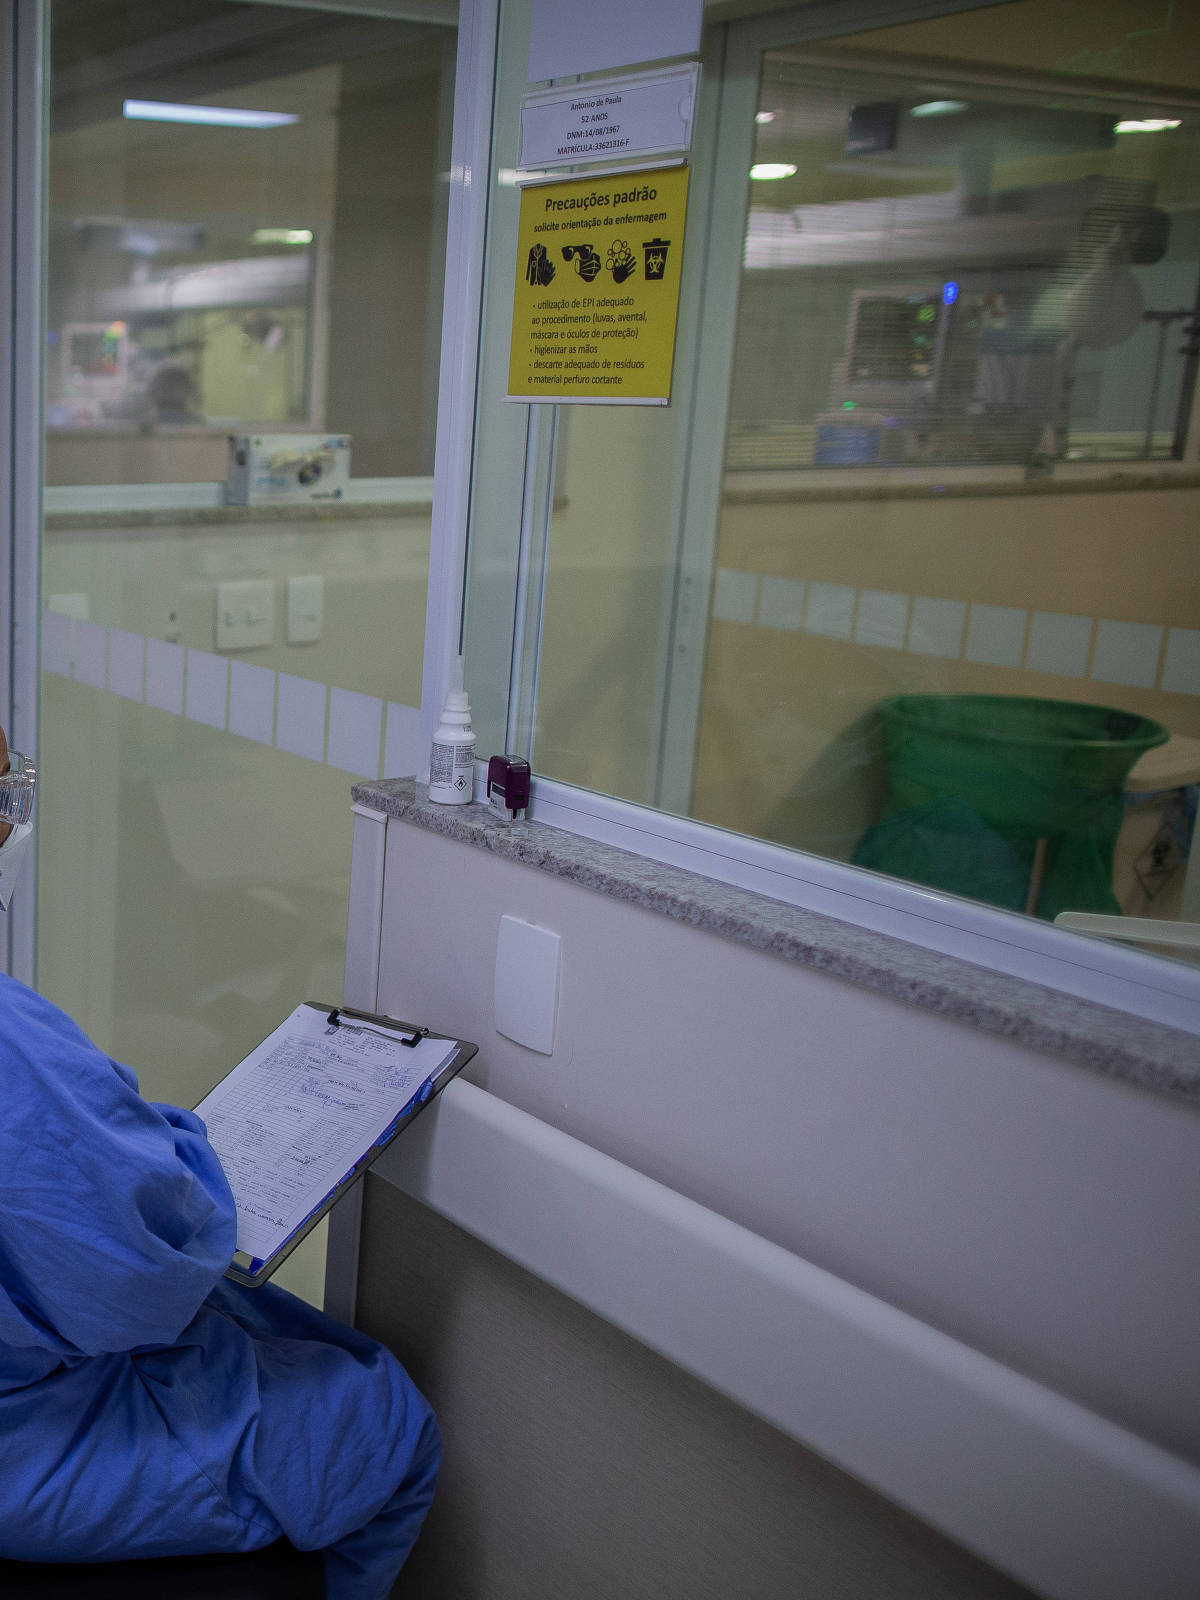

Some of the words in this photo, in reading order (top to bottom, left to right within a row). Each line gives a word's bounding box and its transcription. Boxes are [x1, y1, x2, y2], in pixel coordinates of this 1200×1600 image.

[571, 100, 595, 111] Antonio
[605, 96, 622, 105] Paula
[591, 112, 608, 122] ANOS
[545, 192, 610, 212] Precauções
[613, 186, 657, 208] padrão
[534, 222, 559, 232] solicite
[561, 218, 601, 230] orientação
[603, 216, 613, 225] da
[615, 212, 667, 224] enfermagem
[538, 299, 570, 310] utilização
[571, 299, 580, 308] de
[582, 298, 594, 308] EPI
[596, 296, 635, 308] adequado
[531, 317, 540, 325] ao
[542, 314, 591, 327] procedimento
[592, 313, 616, 324] (luvas,
[618, 312, 647, 322] avental,
[530, 330, 559, 339] máscara
[567, 329, 590, 338] óculos
[591, 329, 601, 338] de
[602, 327, 638, 339] proteção)
[534, 344, 567, 356] higienizar
[569, 346, 576, 354] as
[578, 344, 597, 354] mãos
[534, 360, 562, 368] descarte
[564, 359, 600, 370] adequado
[602, 359, 611, 368] de
[613, 358, 645, 368] resíduos
[534, 375, 562, 384] material
[563, 375, 589, 385] perfuro
[592, 375, 623, 384] cortante
